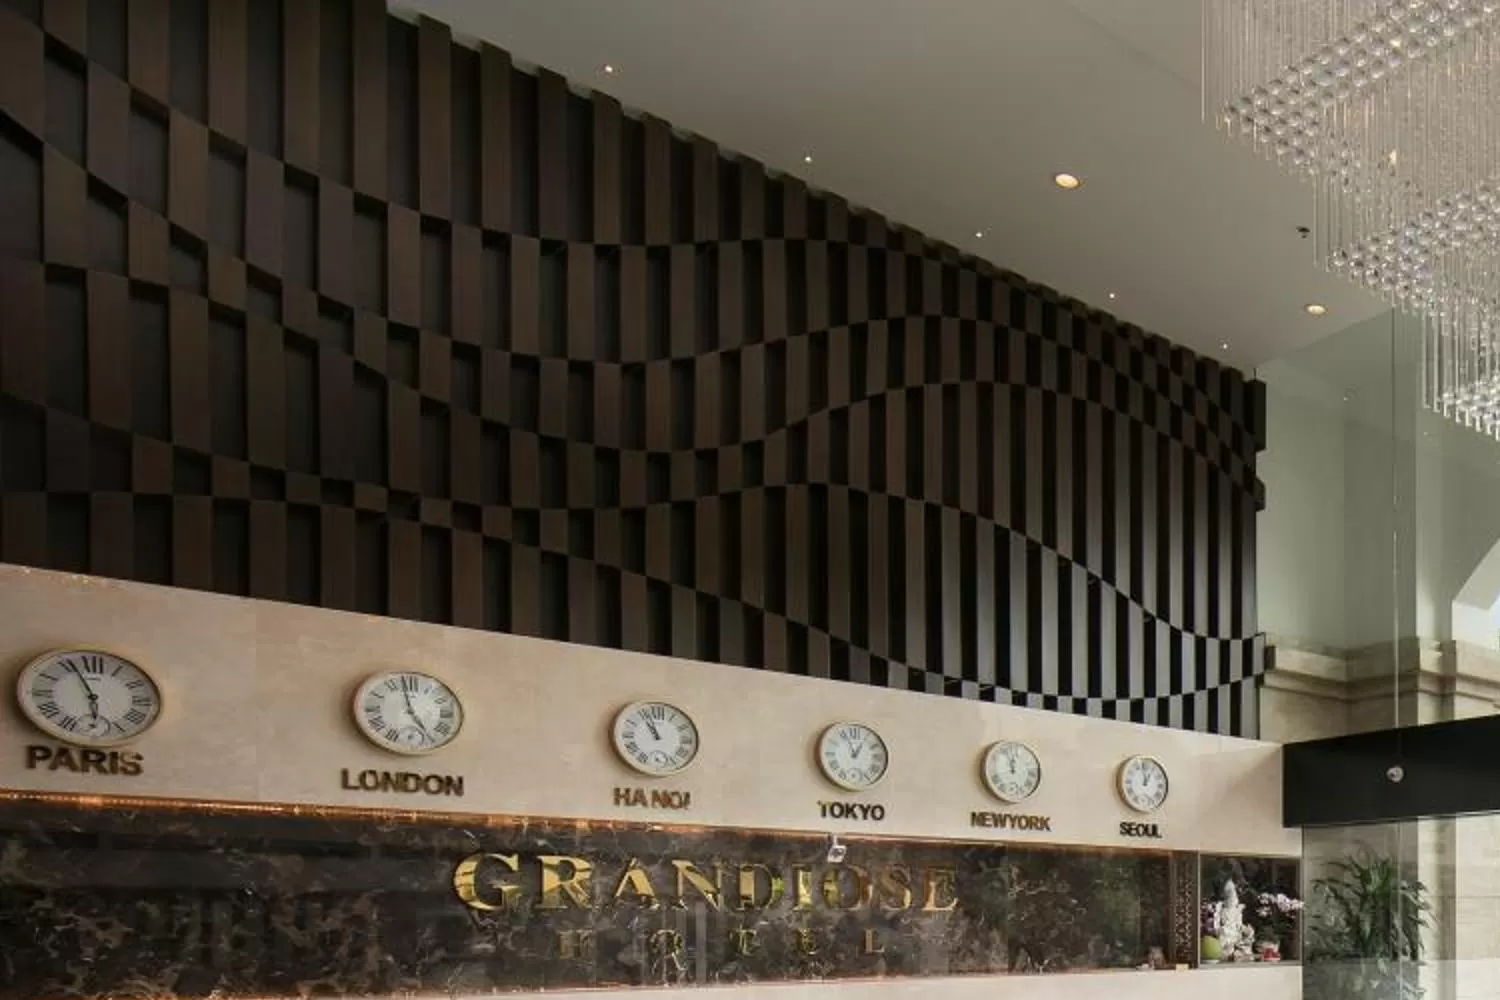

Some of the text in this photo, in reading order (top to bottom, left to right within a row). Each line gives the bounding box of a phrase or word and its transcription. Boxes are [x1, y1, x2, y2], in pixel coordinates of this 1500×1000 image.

[26, 745, 144, 776] PARIS
[341, 767, 464, 797] LONDON
[816, 800, 885, 821] TOKYO
[1119, 822, 1163, 838] SEOUL
[453, 852, 958, 911] GRANDIOSE
